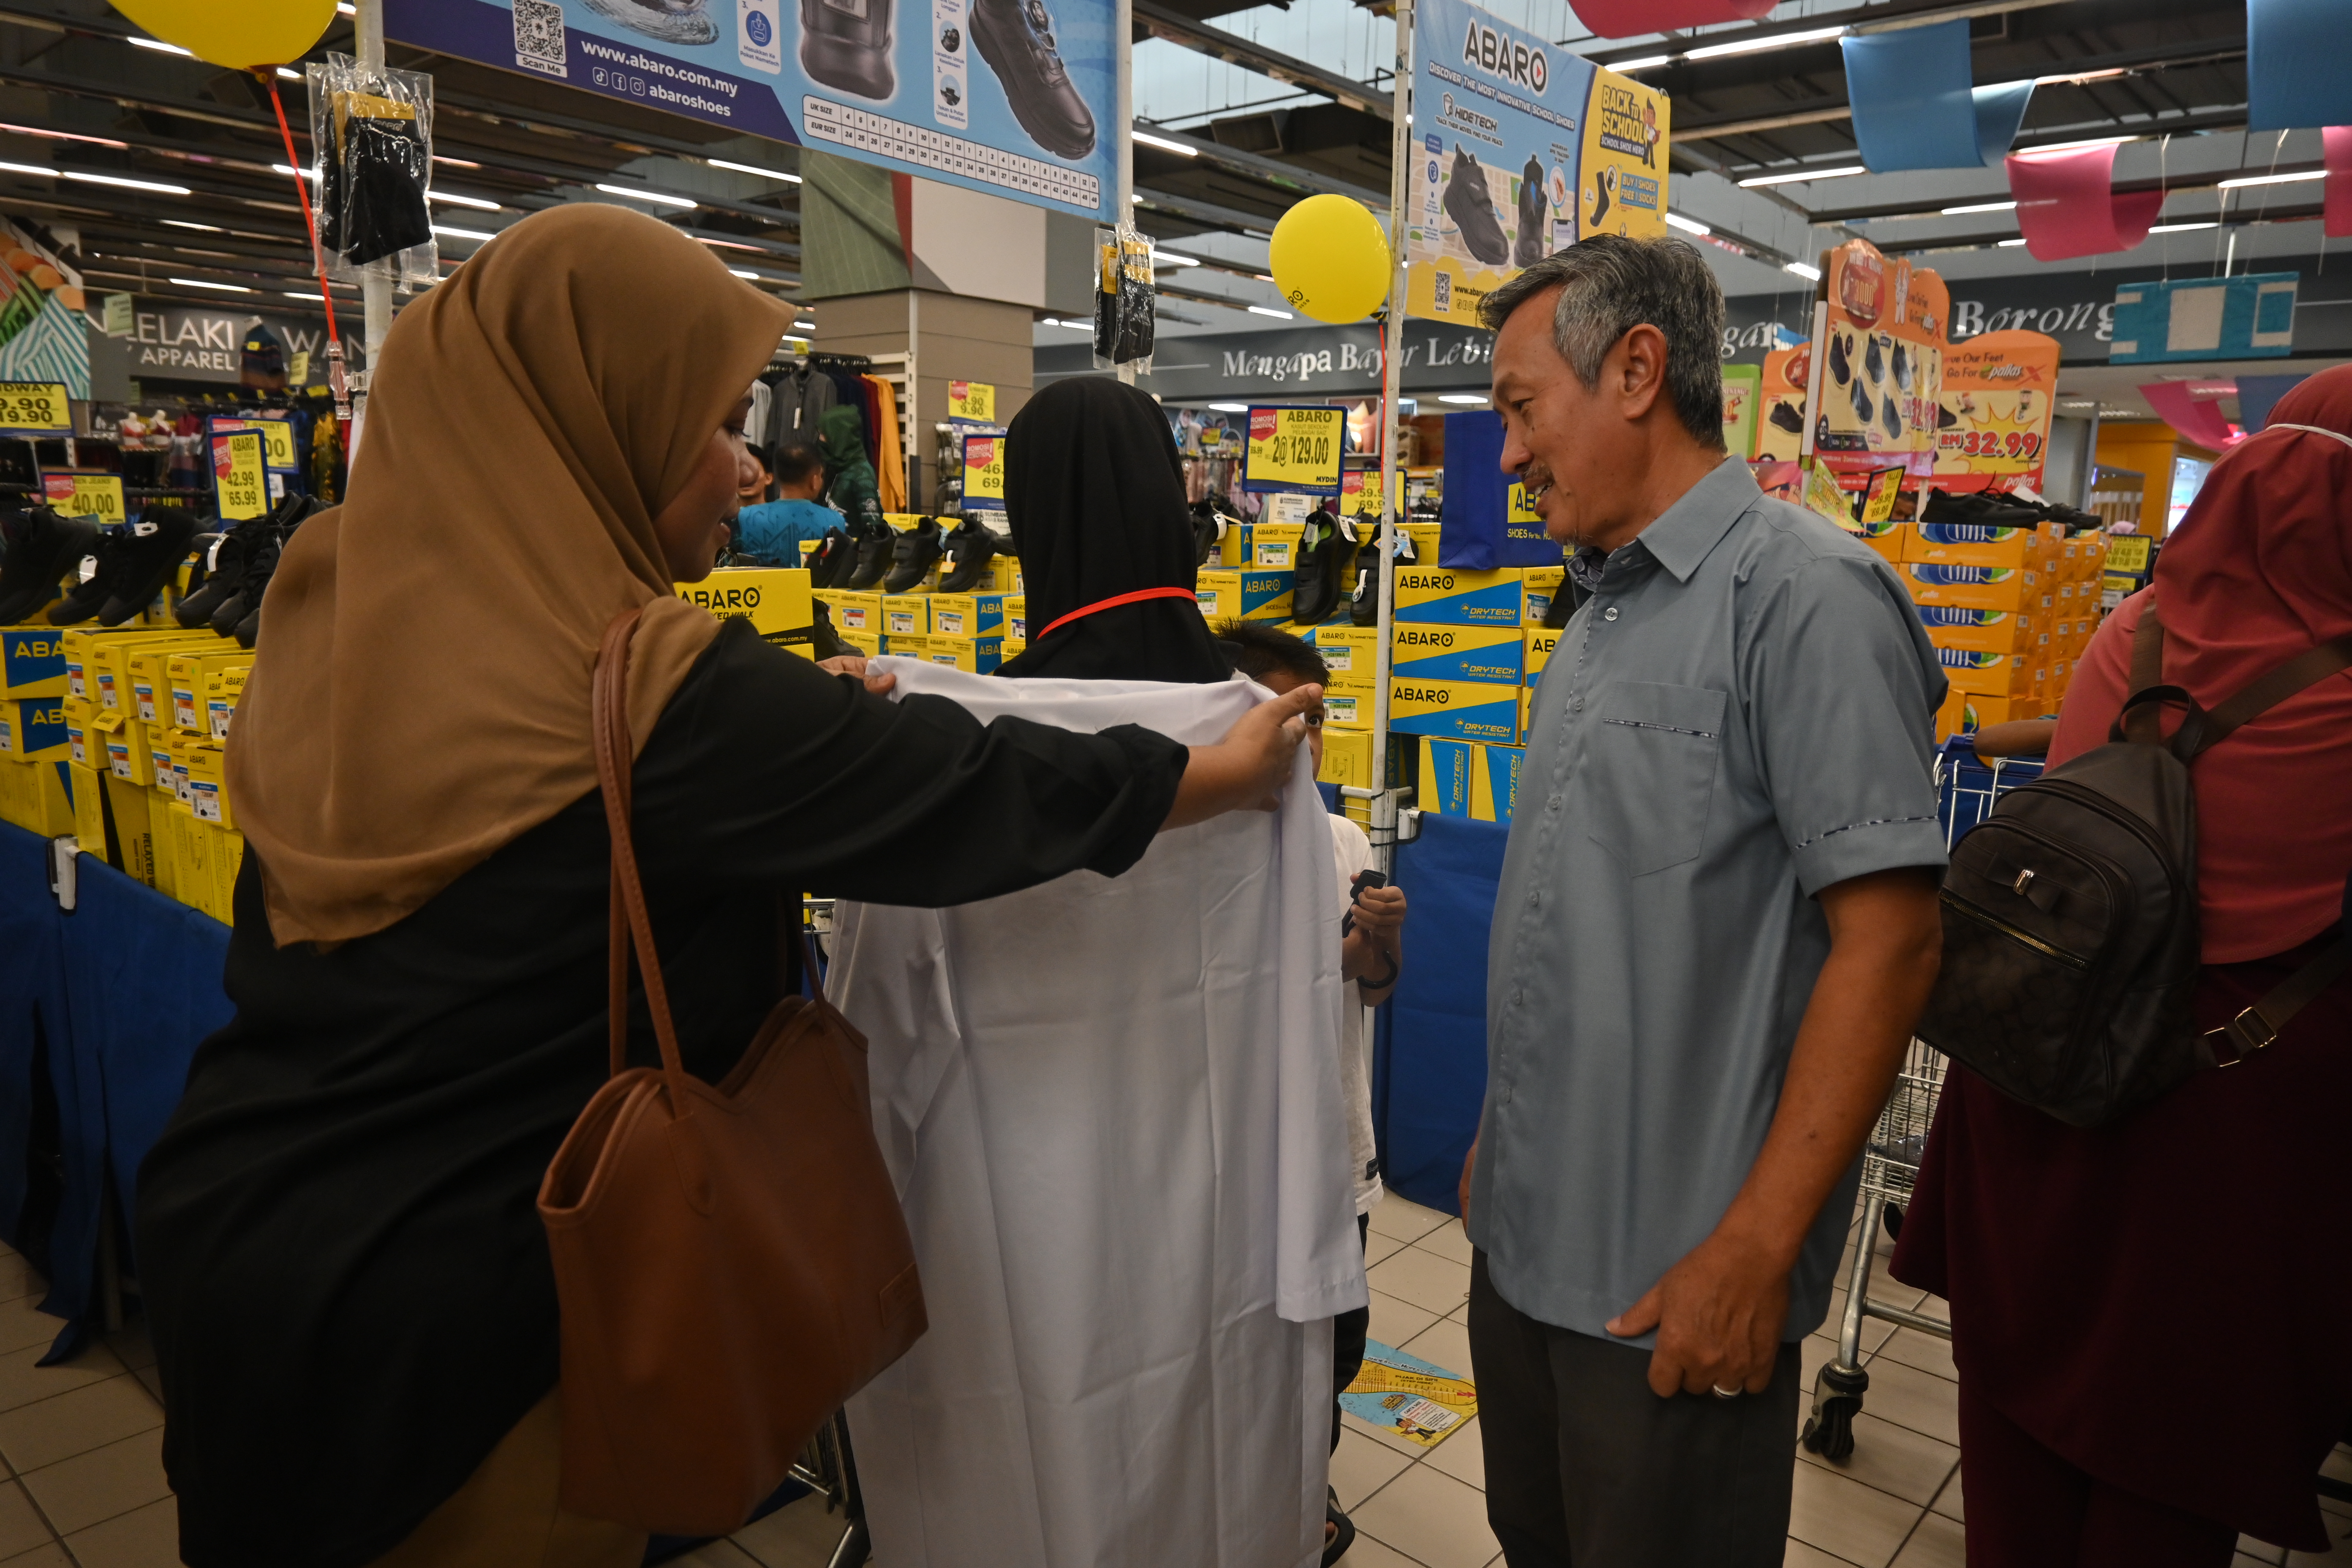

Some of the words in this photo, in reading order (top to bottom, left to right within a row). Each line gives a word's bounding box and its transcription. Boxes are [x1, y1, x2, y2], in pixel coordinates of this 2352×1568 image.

[742, 0, 748, 9] 3.
[1464, 20, 1547, 93] ABARO
[523, 57, 544, 71] Scan
[548, 65, 561, 74] Me
[581, 41, 738, 97] www.abaro.com.my
[649, 84, 730, 117] abaroshoes
[1429, 61, 1462, 85] DISCOVER
[1464, 75, 1476, 91] THE
[1478, 81, 1496, 99] MOST
[1497, 89, 1531, 114] INNOVATIVE
[1532, 103, 1554, 124] SCHOOL
[1556, 113, 1575, 131] SHOES
[1602, 85, 1634, 115] BACK
[1631, 104, 1640, 120] TO
[811, 103, 819, 111] UK
[819, 106, 832, 114] SIZE
[1455, 107, 1497, 131] HIDETECH
[1603, 110, 1645, 144] SCHOOL
[811, 122, 823, 130] EUR
[824, 125, 836, 133] SIZE
[1473, 130, 1481, 138] FIND
[1482, 134, 1491, 142] YOUR
[1601, 136, 1619, 149] SCHOOL
[1620, 141, 1631, 152] SHOE
[1633, 144, 1644, 156] HERO
[1622, 176, 1634, 188] BUY
[1639, 180, 1655, 192] SHOES
[1621, 188, 1634, 199] FREE
[1639, 193, 1656, 205] SOCKS
[127, 313, 234, 351] ELAKI
[1222, 349, 1332, 381] Mengapa
[1952, 301, 2115, 341] Borong
[140, 348, 234, 371] APPAREL
[1964, 353, 1979, 362] Our
[1984, 353, 2004, 362] Feet
[1947, 368, 1960, 378] Go
[1963, 368, 1977, 377] For
[1988, 364, 2022, 380] pallas
[961, 406, 983, 415] 9.90
[1287, 411, 1332, 423] ABARO
[232, 437, 254, 452] ABARO
[1291, 436, 1329, 465] 129.00
[1940, 434, 1962, 447] RM
[1964, 432, 2041, 458] 32.99
[983, 464, 1004, 474] 46.
[1886, 471, 1900, 481] PALLAS
[227, 471, 254, 486] 42.99
[983, 478, 1003, 488] 69.
[2004, 474, 2036, 489] pallas
[72, 494, 114, 514] 40.00
[229, 491, 256, 506] 65.99
[1871, 506, 1889, 518] 69.99
[1508, 528, 1527, 539] SHOES
[1246, 579, 1280, 593] ABARO
[1399, 575, 1454, 590] ABARO
[681, 587, 760, 609] ABARO
[980, 603, 1002, 614] ABA
[1397, 631, 1453, 647] ABARO
[14, 640, 63, 658] ABA
[1470, 666, 1516, 675] DRYTECH
[225, 677, 245, 686] ABARO
[1394, 686, 1449, 704] ABARO
[1465, 723, 1511, 733] DRYTECH
[190, 755, 205, 765] ABARO
[1510, 754, 1518, 807] DRYTECH
[143, 833, 153, 874] RELAXED
